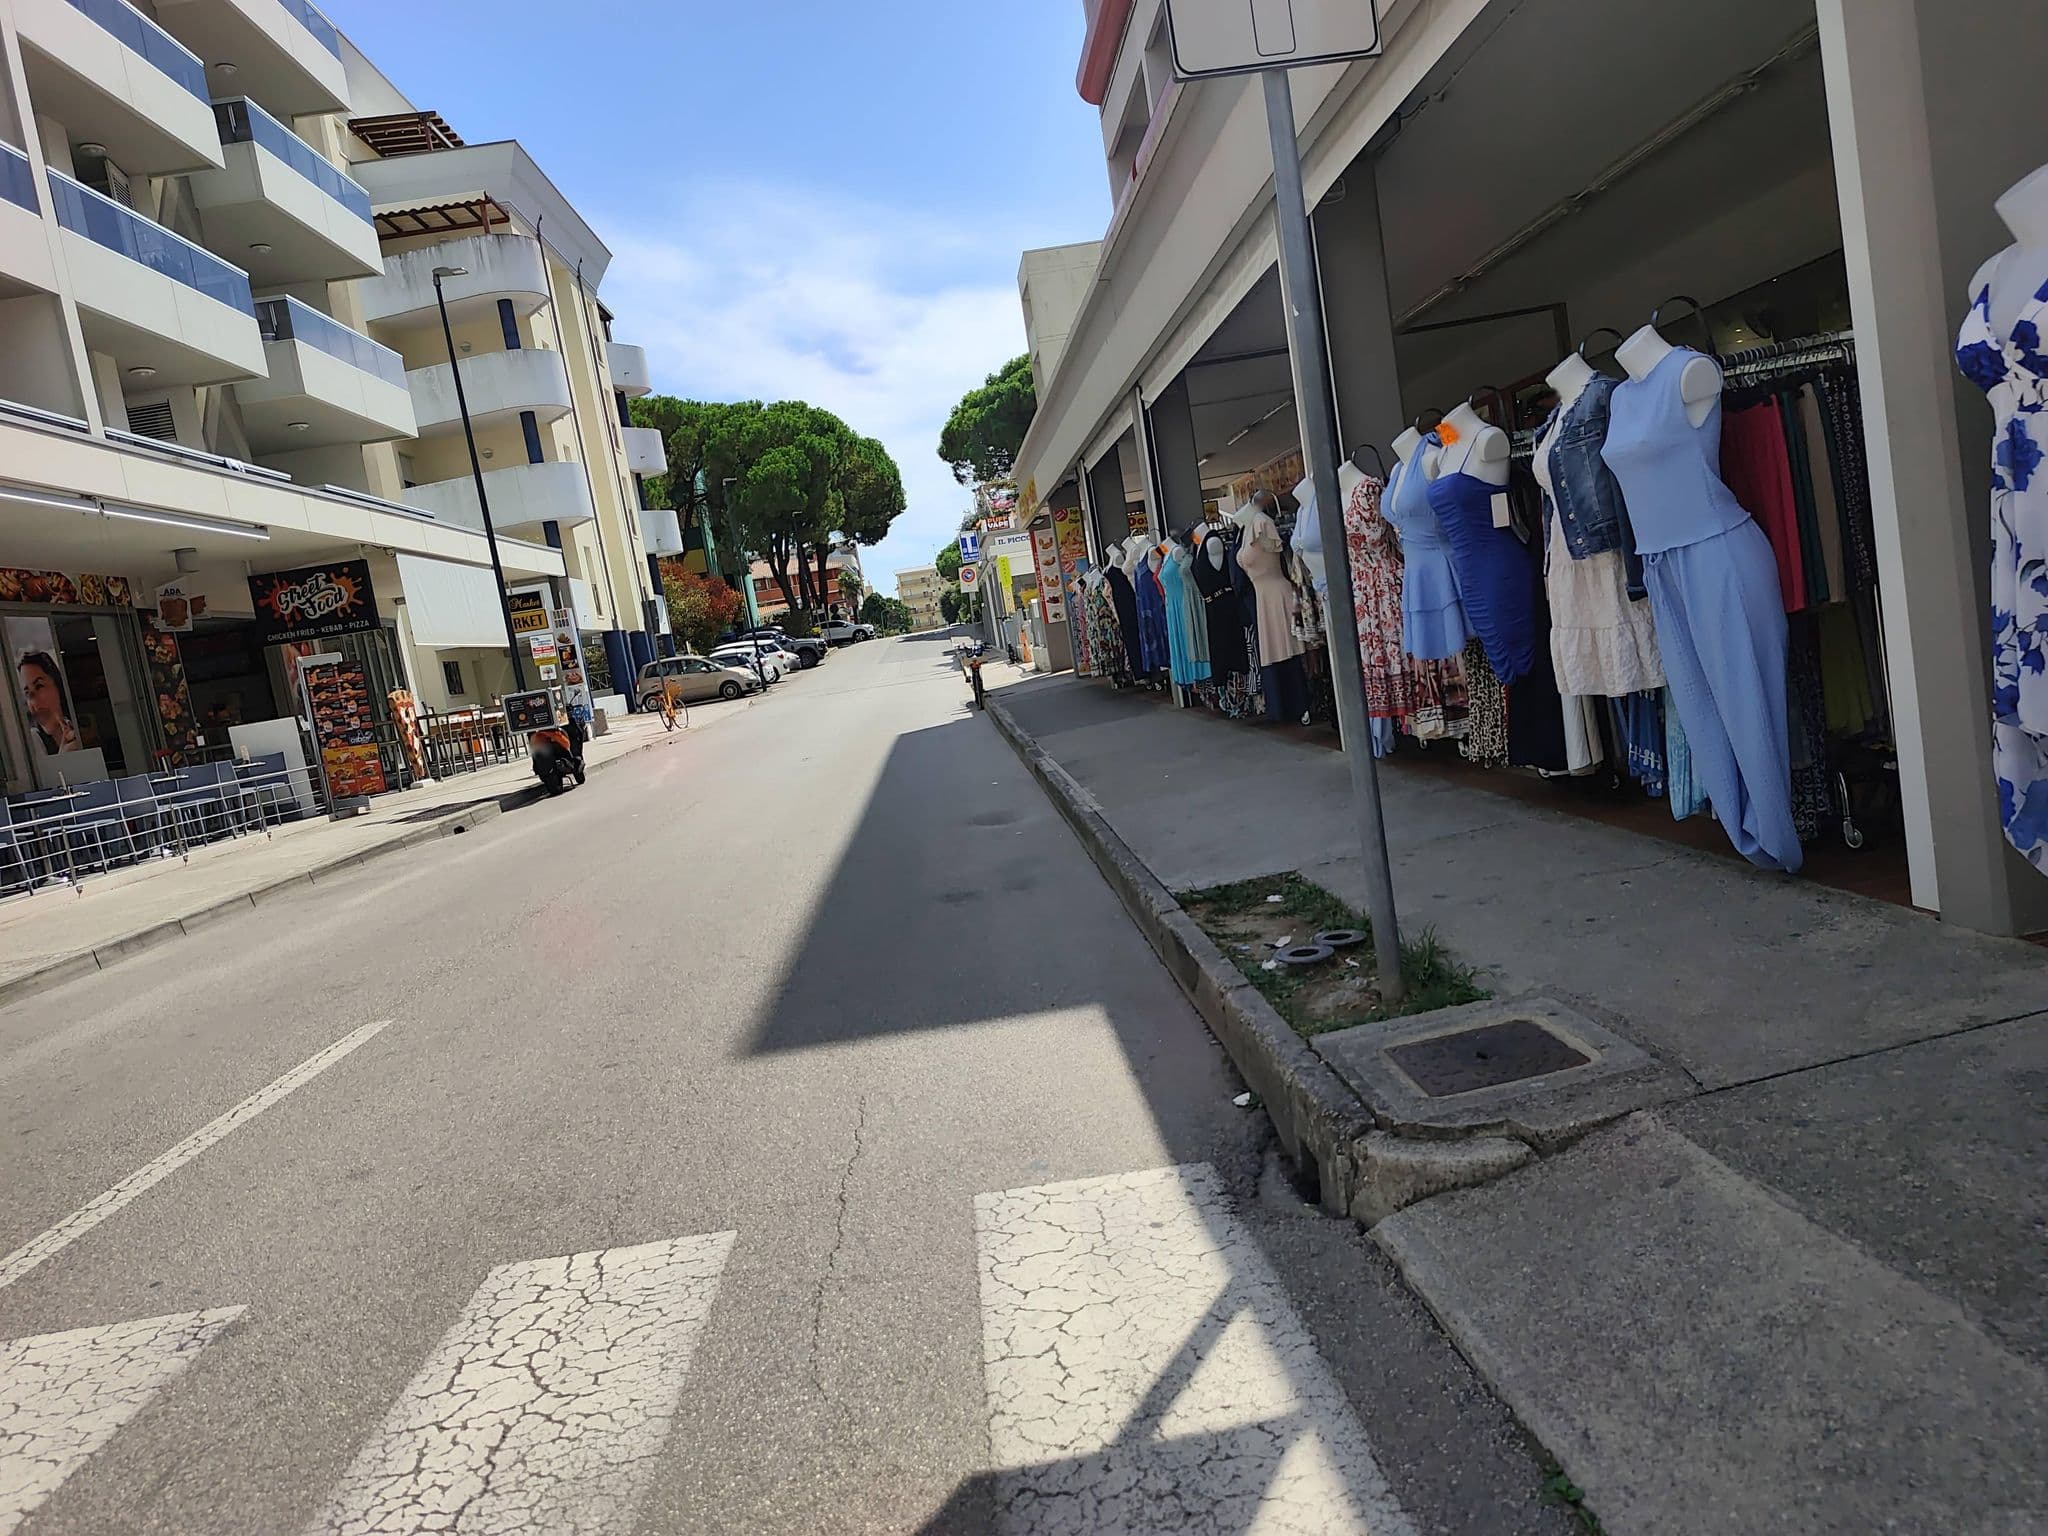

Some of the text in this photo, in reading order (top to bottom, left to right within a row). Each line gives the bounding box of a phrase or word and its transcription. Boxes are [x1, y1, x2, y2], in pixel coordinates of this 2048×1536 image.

[987, 521, 1009, 529] VAPE
[278, 573, 327, 613] Street
[300, 584, 346, 618] Food
[267, 631, 296, 641] CHICKEN
[296, 628, 315, 637] FRIED
[321, 623, 343, 633] KEBAB
[349, 619, 370, 629] PIZZA
[512, 614, 543, 630] RKET
